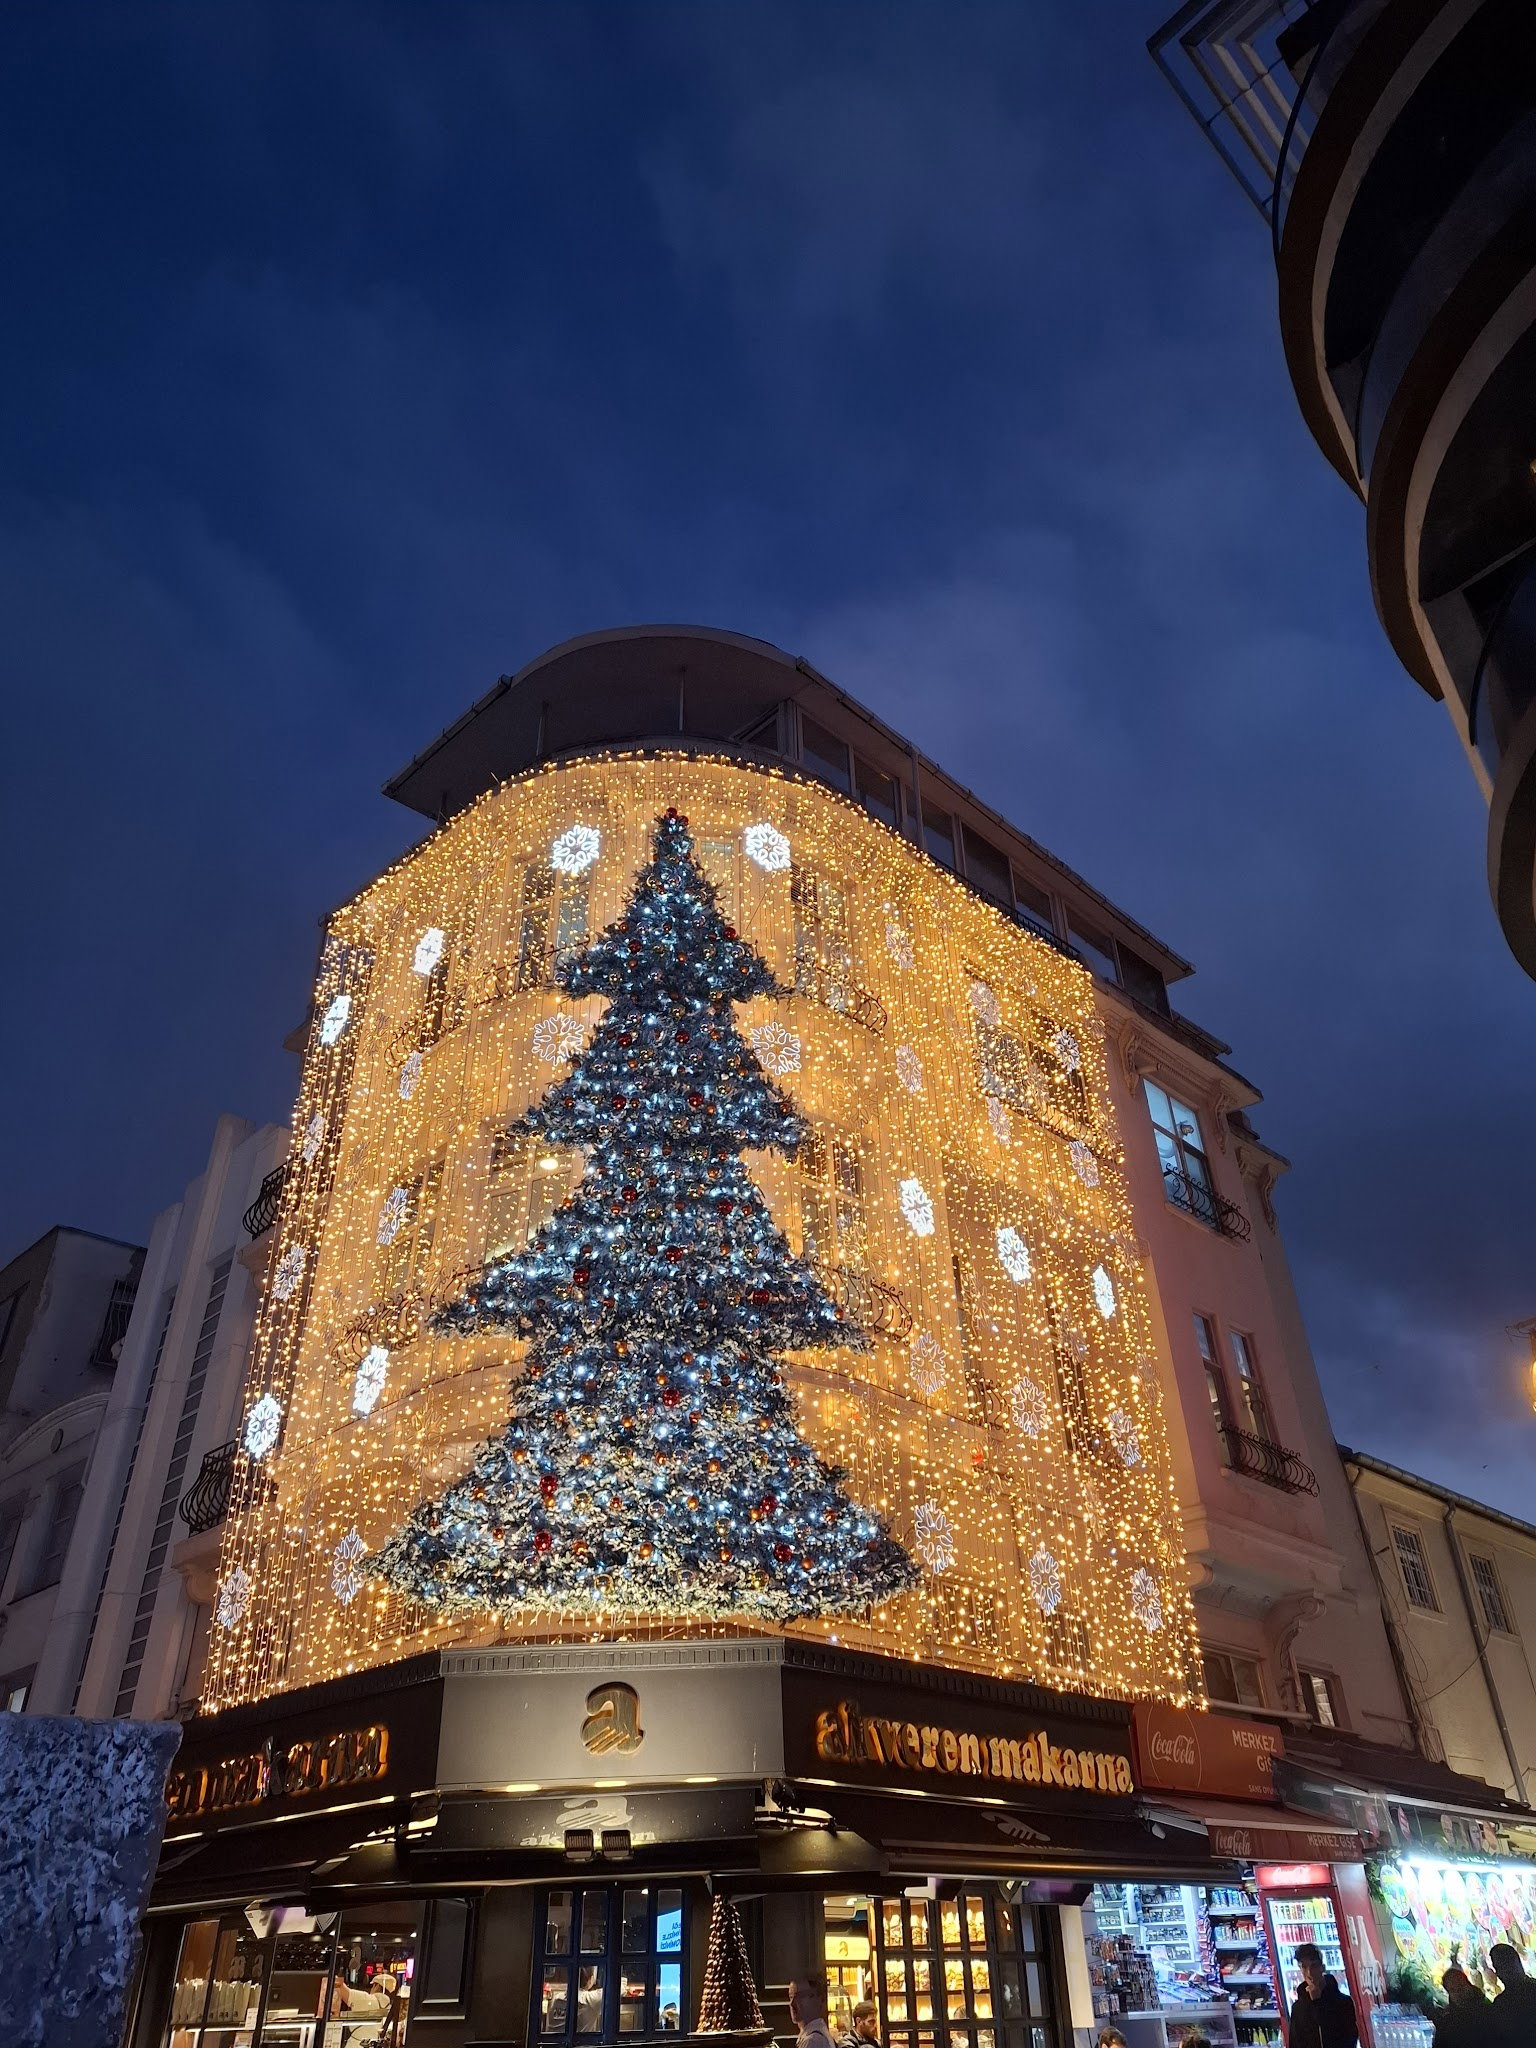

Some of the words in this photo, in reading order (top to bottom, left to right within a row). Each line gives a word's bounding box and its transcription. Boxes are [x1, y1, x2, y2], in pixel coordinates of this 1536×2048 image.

[1151, 1731, 1195, 1766] Coca-Cola
[1232, 1729, 1277, 1753] MERKEZ
[209, 1723, 389, 1808] makarna
[983, 1730, 1134, 1794] makarna
[1307, 1833, 1340, 1848] MERKEZ
